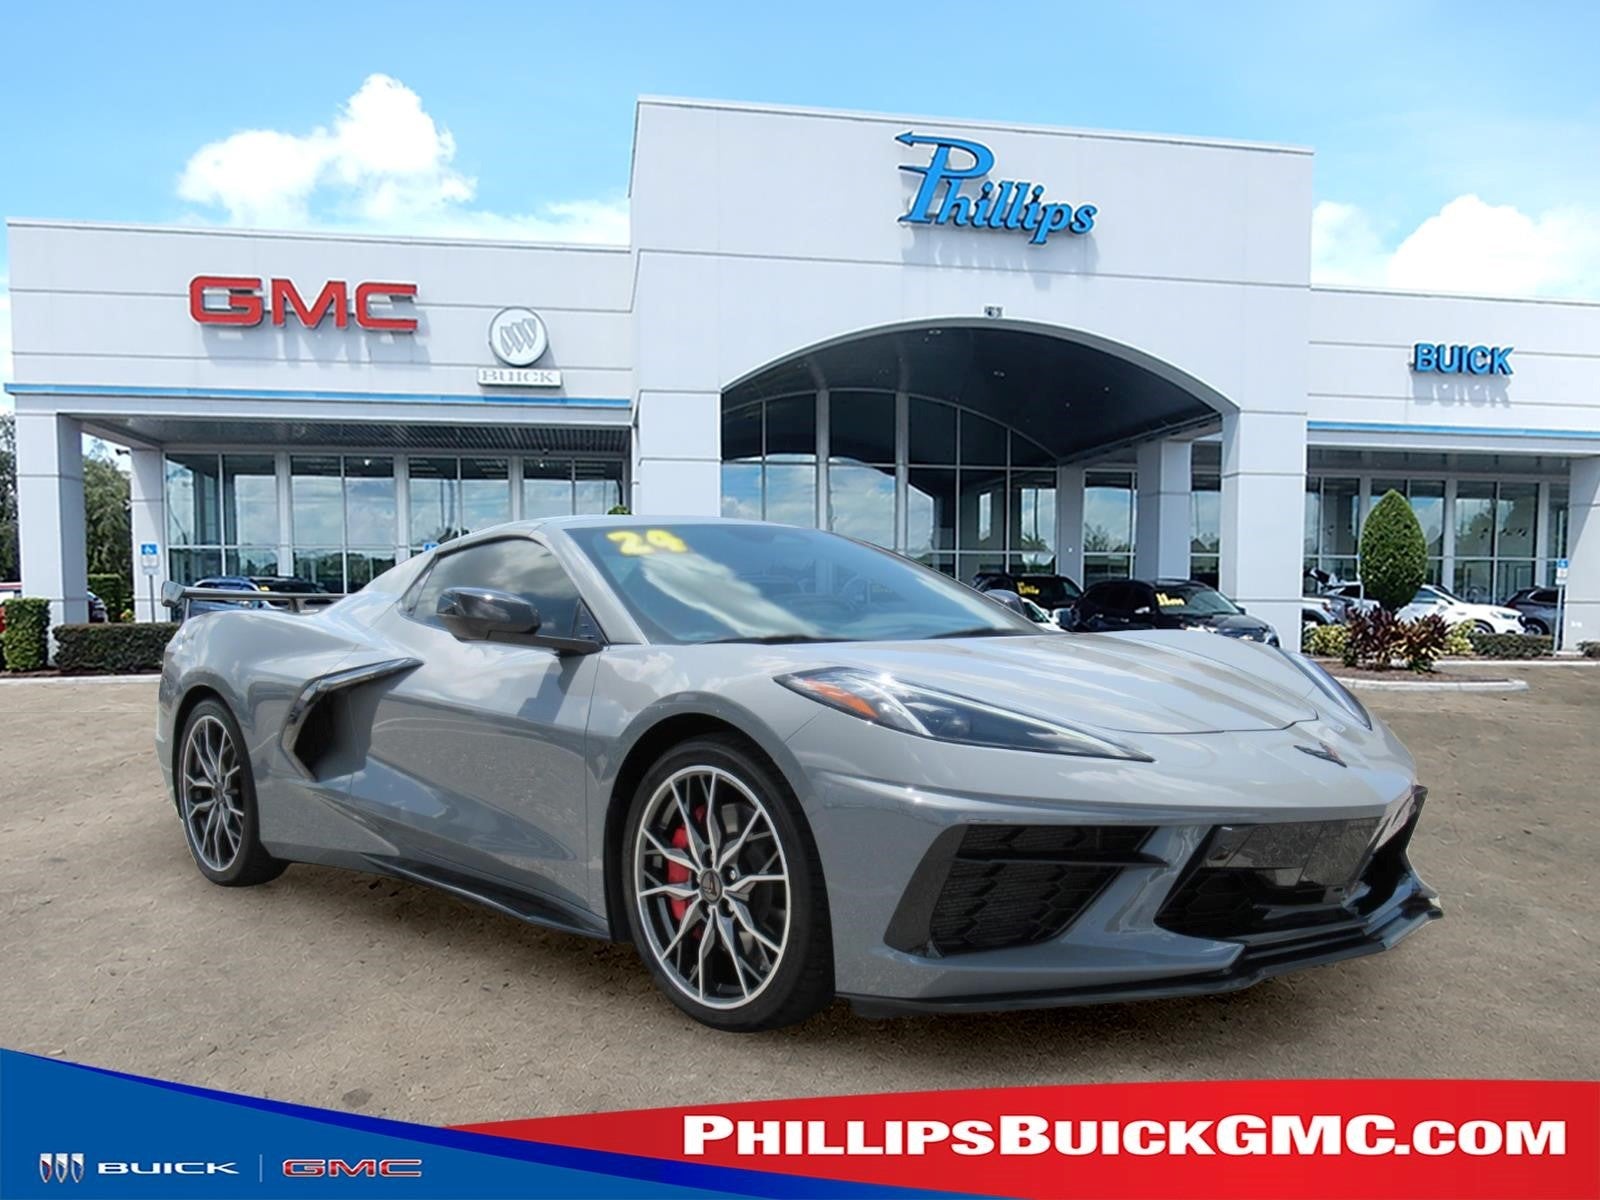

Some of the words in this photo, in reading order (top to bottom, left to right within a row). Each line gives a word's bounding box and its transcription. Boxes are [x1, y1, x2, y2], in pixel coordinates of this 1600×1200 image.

[895, 131, 1097, 244] Phillips
[189, 276, 418, 331] GMC
[481, 369, 554, 383] BUICK
[1414, 343, 1514, 375] BUICK
